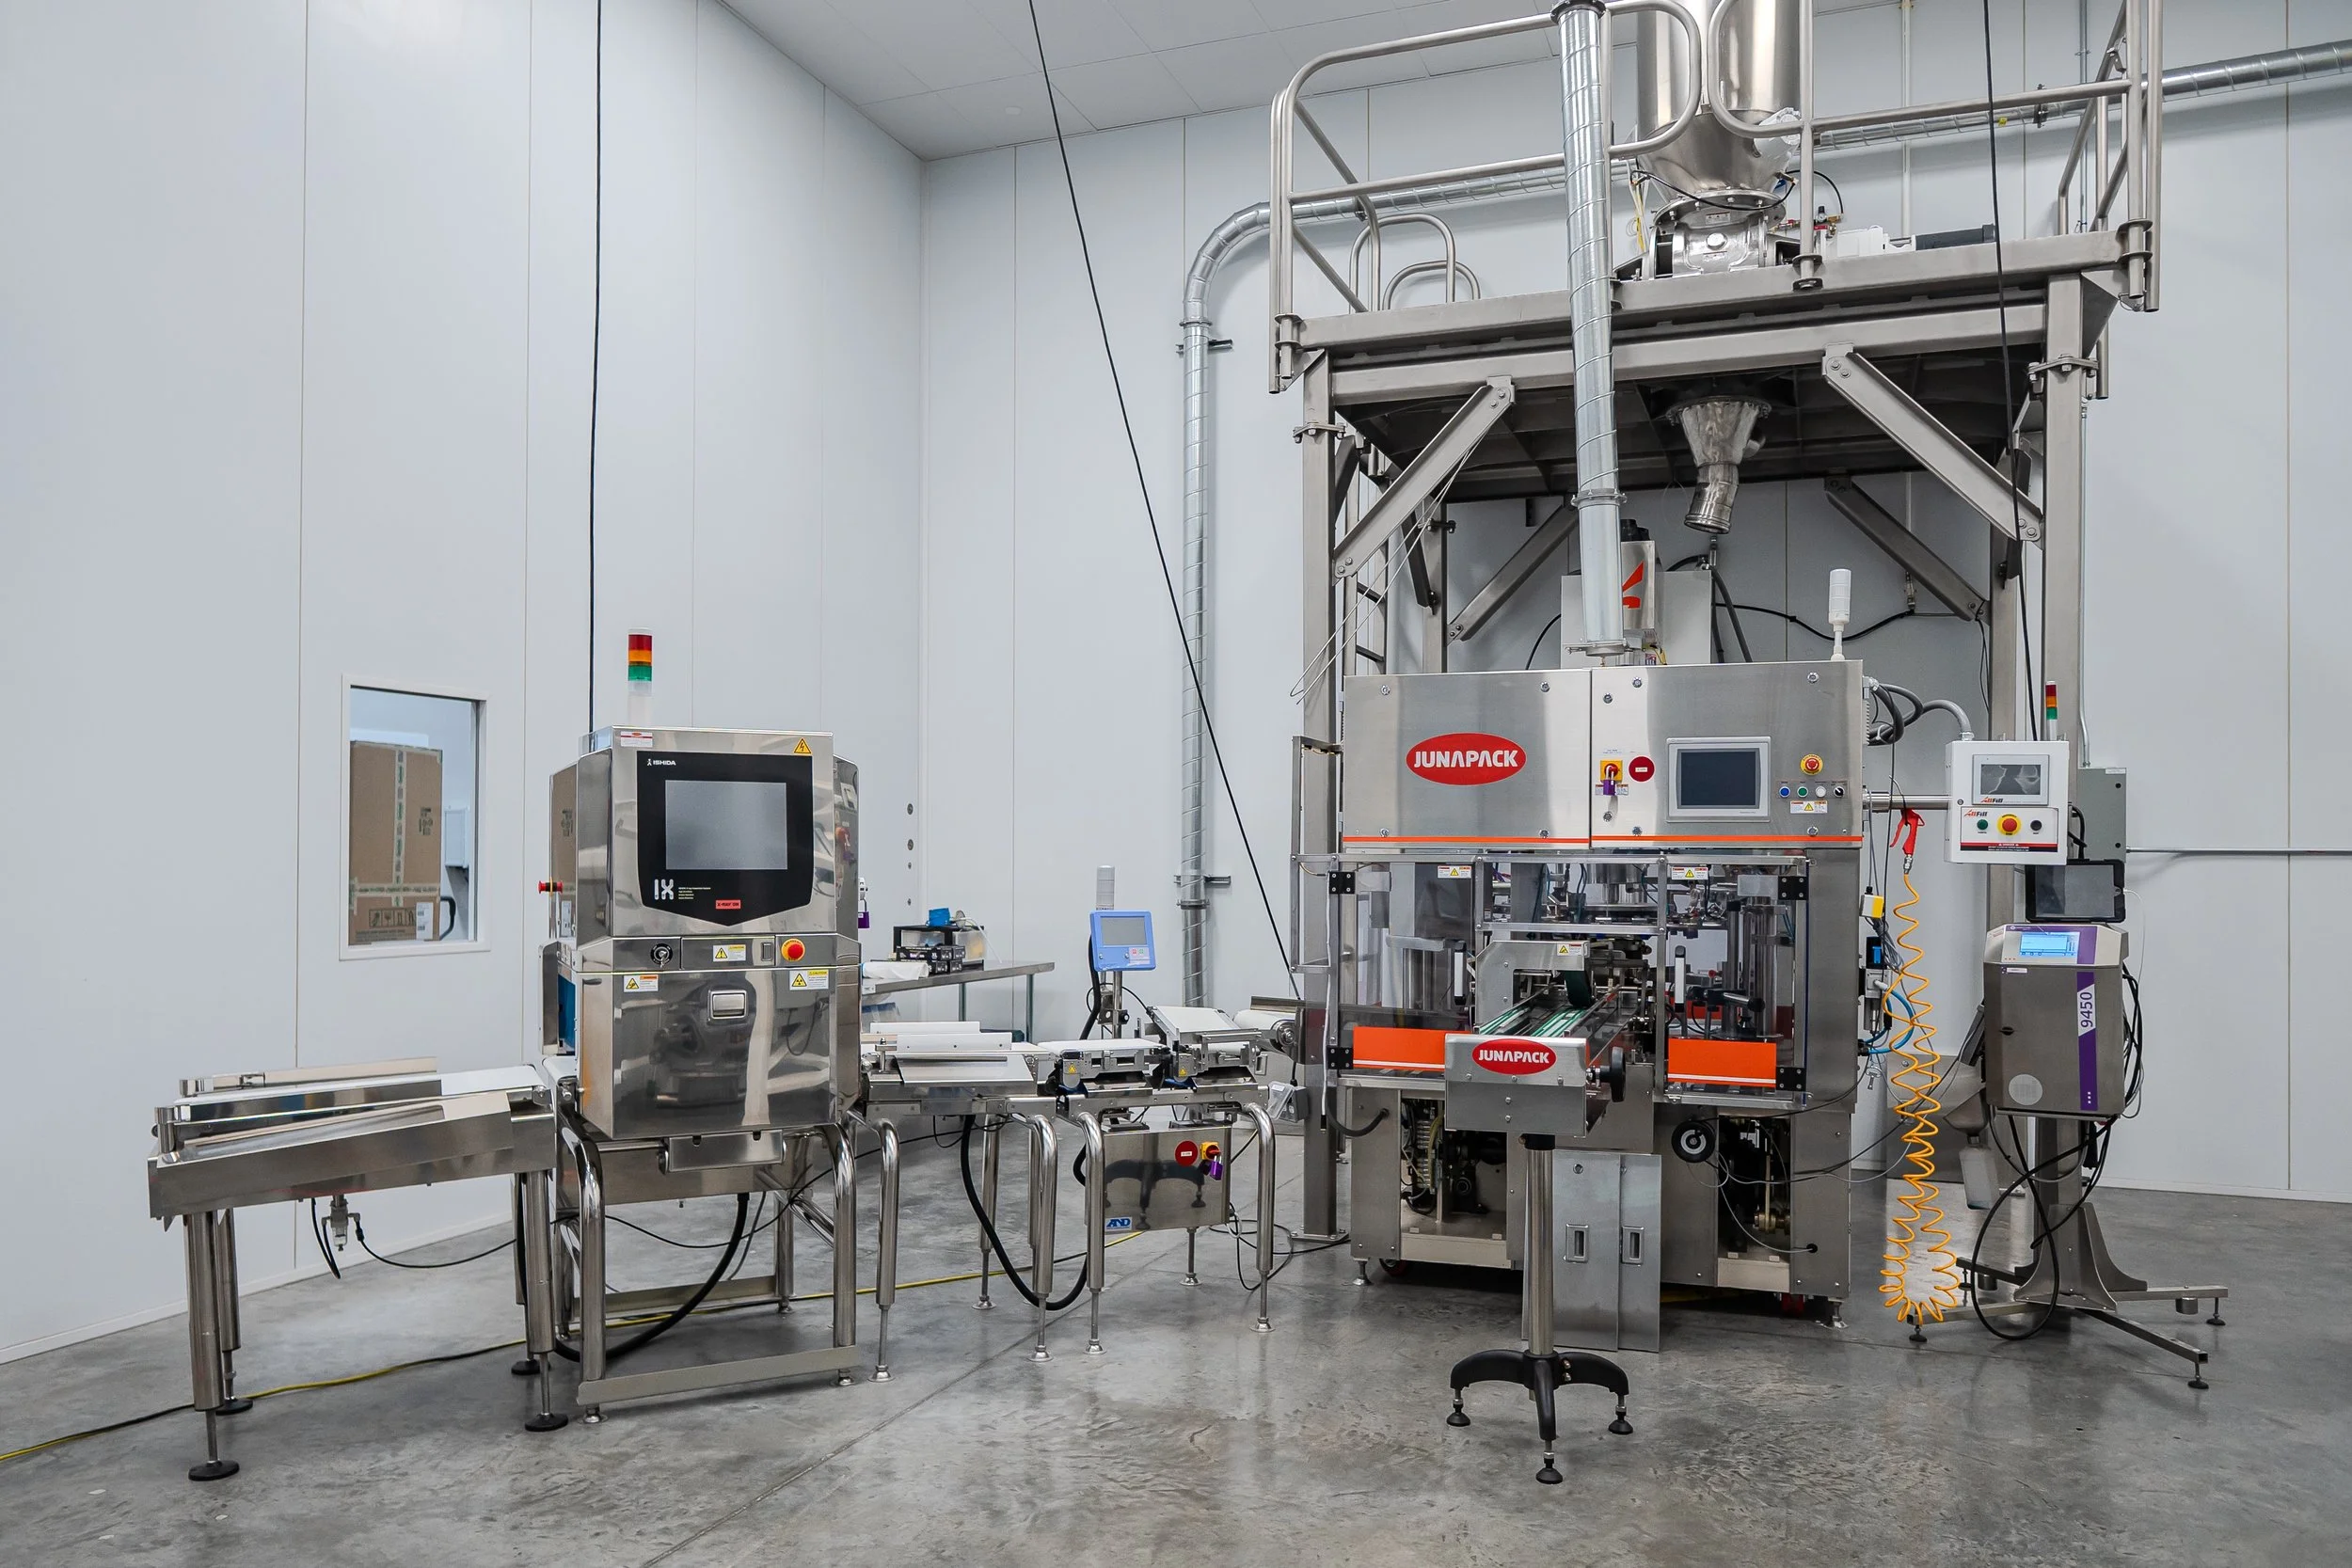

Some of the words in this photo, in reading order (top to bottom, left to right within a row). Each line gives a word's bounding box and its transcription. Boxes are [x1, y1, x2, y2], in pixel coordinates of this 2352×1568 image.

[1414, 751, 1518, 768] JUNAPACK
[654, 879, 675, 900] IX
[2080, 991, 2093, 1027] 9450
[1478, 1050, 1549, 1064] JUNAPACK
[1106, 1218, 1131, 1227] AND
